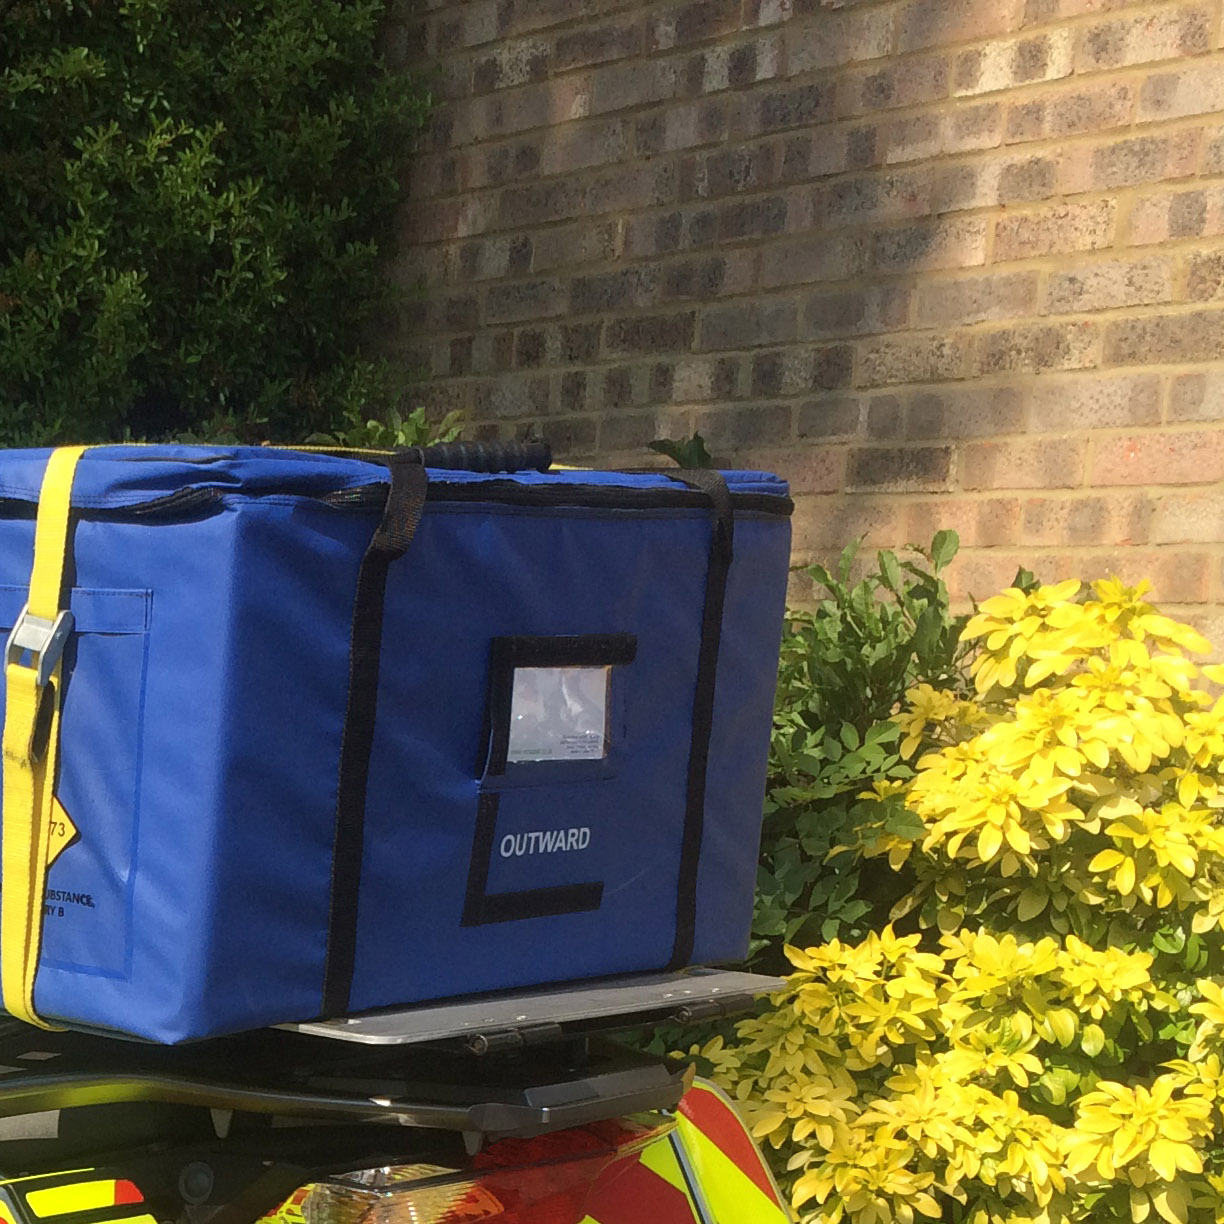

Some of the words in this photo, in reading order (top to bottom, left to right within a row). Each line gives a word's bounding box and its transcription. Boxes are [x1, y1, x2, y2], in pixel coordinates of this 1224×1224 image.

[49, 821, 66, 838] 73
[500, 827, 591, 858] OUTWARD
[46, 889, 95, 909] UBSTANCE,
